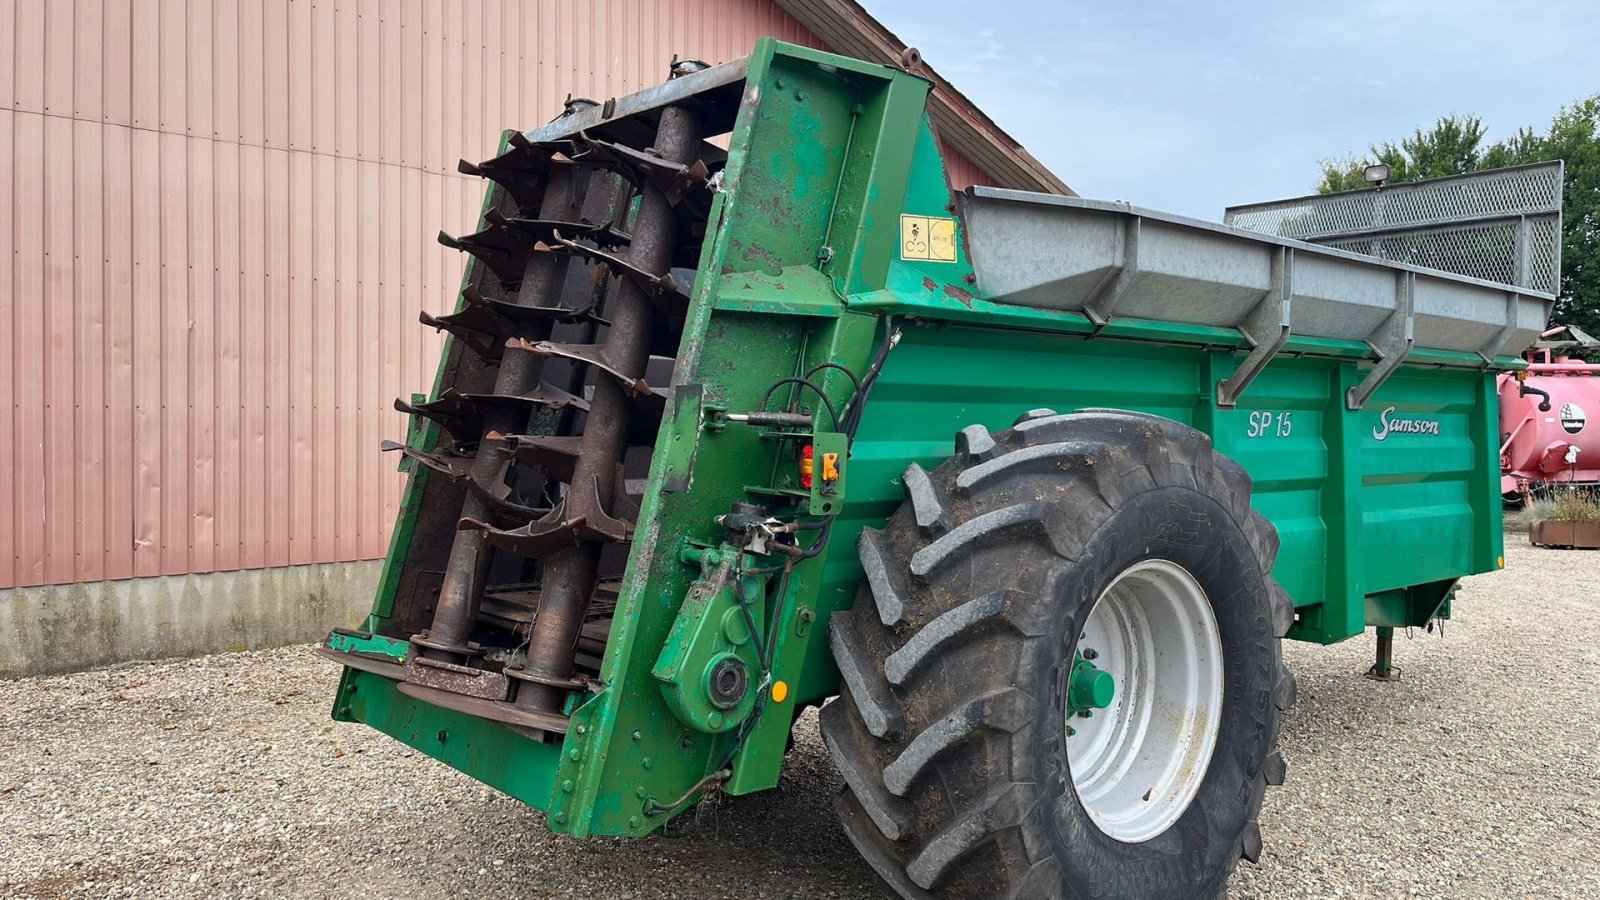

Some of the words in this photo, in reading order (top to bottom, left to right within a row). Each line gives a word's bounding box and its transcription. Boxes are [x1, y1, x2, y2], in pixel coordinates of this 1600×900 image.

[1248, 411, 1272, 438] SP
[1276, 412, 1291, 437] 15
[1373, 406, 1440, 441] Samson
